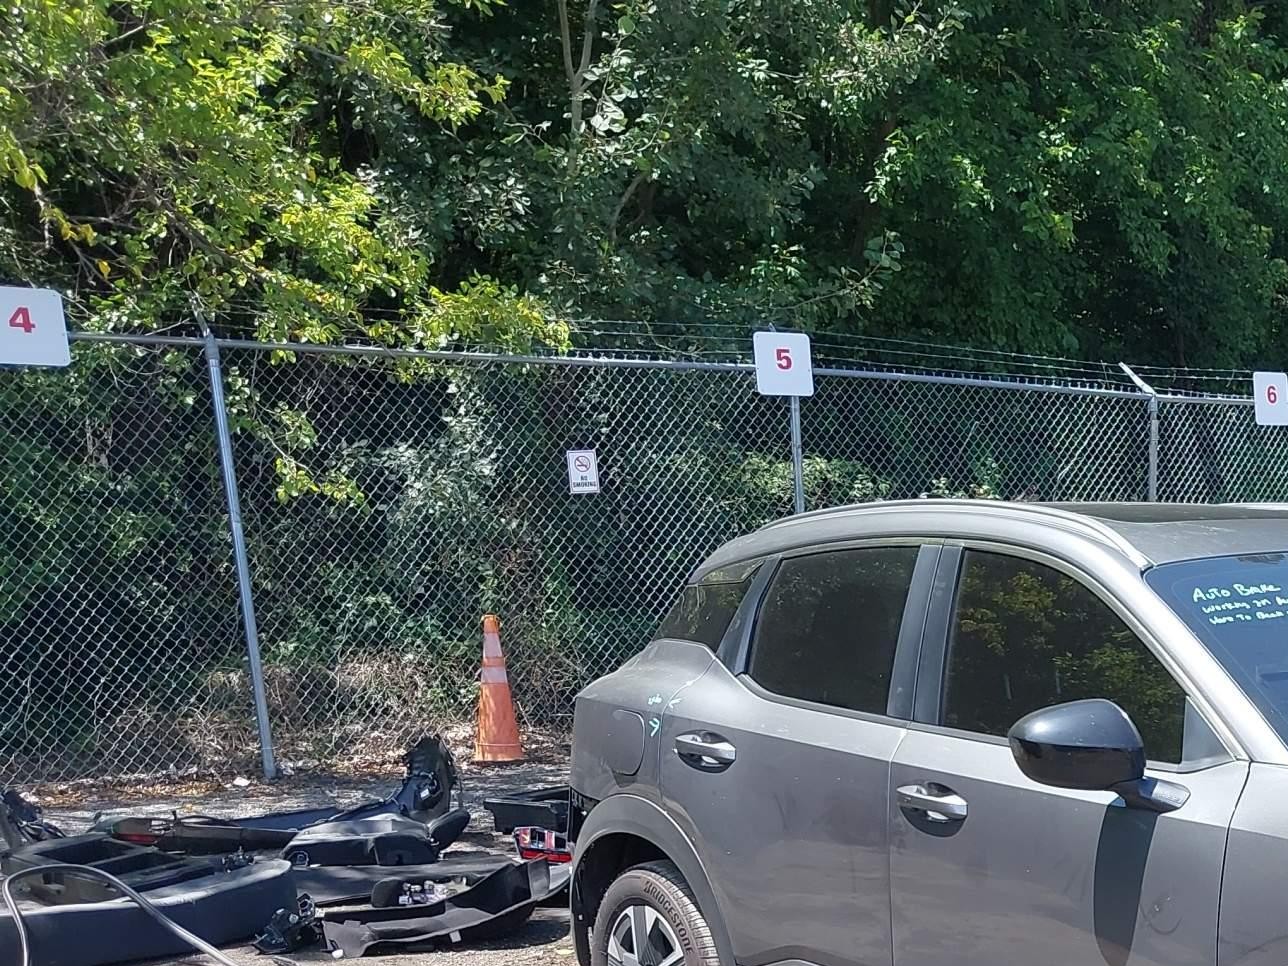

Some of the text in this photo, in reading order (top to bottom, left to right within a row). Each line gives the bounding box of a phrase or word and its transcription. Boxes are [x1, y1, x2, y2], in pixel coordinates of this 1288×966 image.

[9, 307, 36, 333] 4
[776, 349, 792, 369] 5
[1267, 386, 1277, 404] 6
[643, 881, 694, 954] BRIDGESTONE
